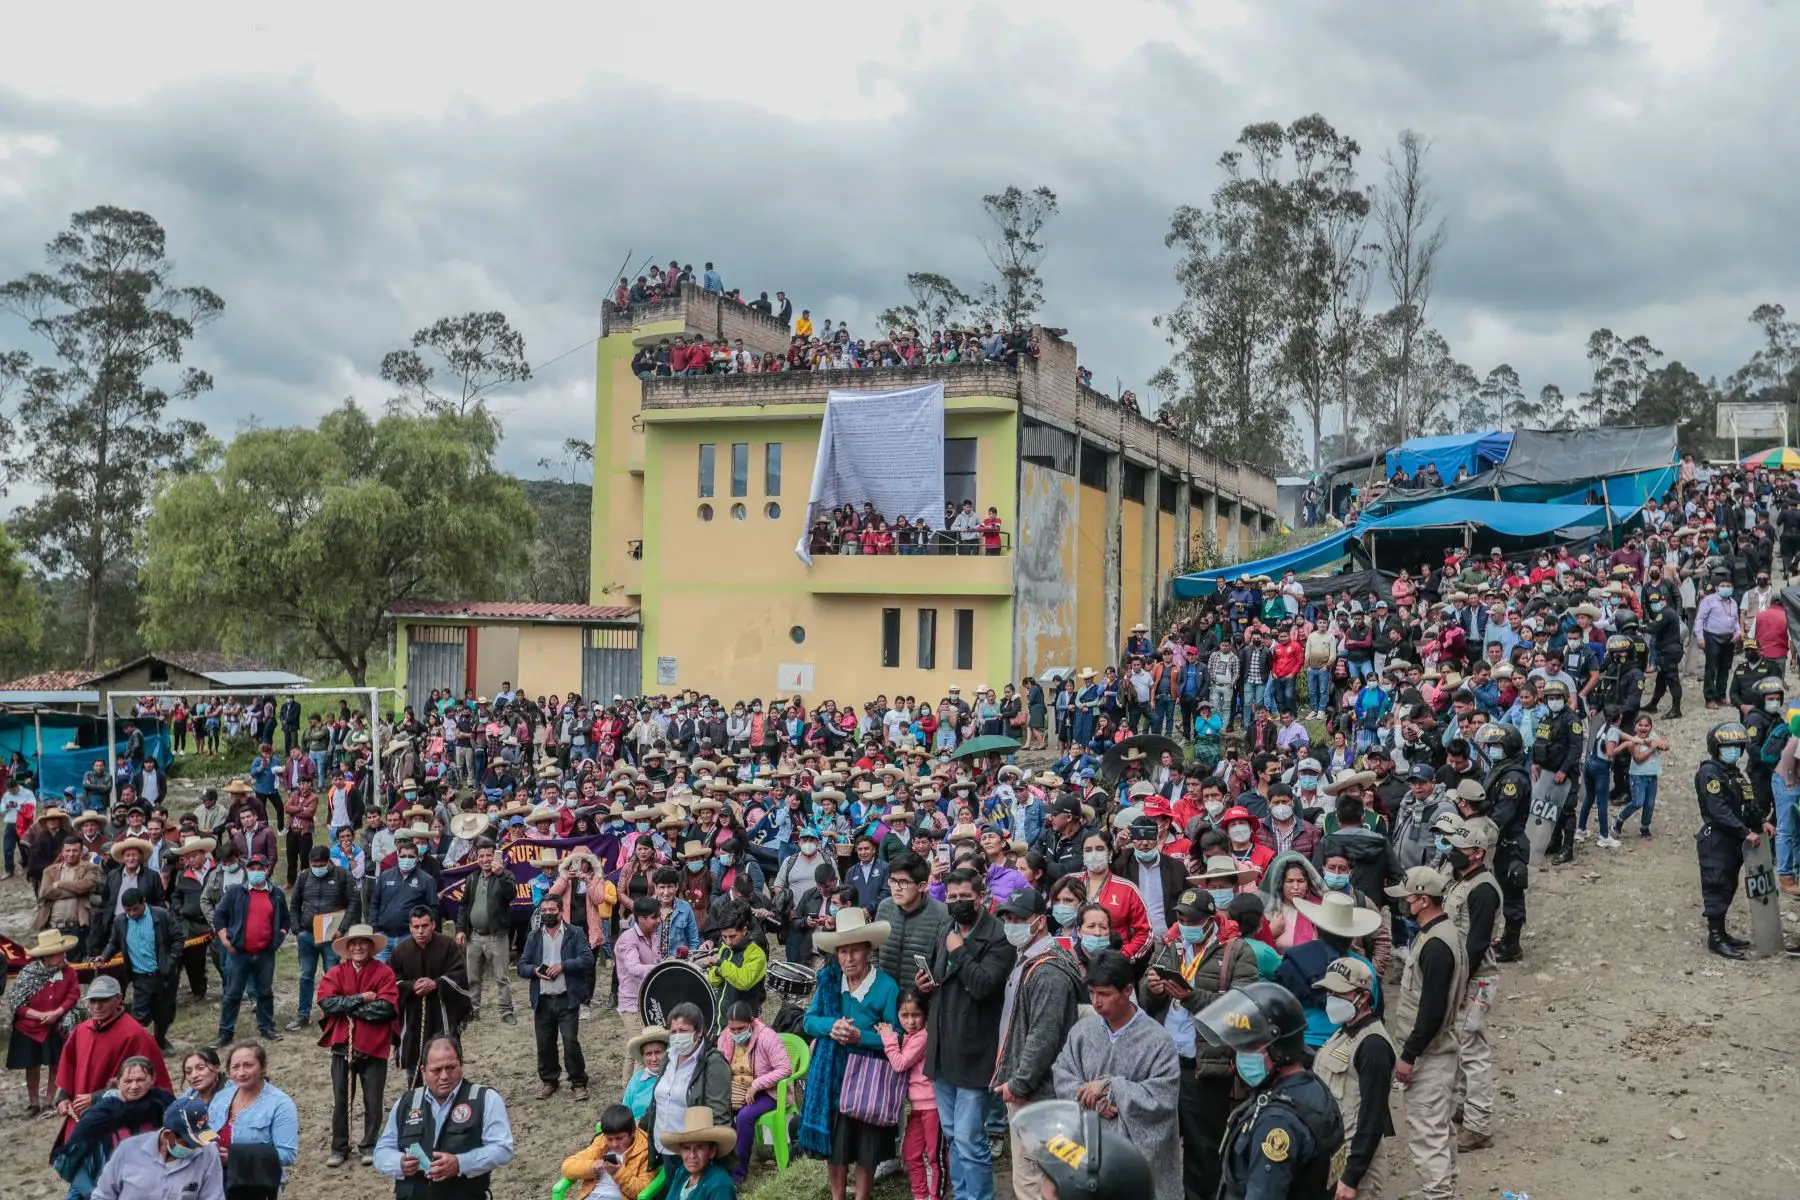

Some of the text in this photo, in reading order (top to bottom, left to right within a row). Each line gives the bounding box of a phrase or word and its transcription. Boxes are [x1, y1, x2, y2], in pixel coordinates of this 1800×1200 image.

[508, 844, 545, 864] NUEV
[1222, 1011, 1251, 1031] CIA
[1045, 1133, 1087, 1170] CIA
